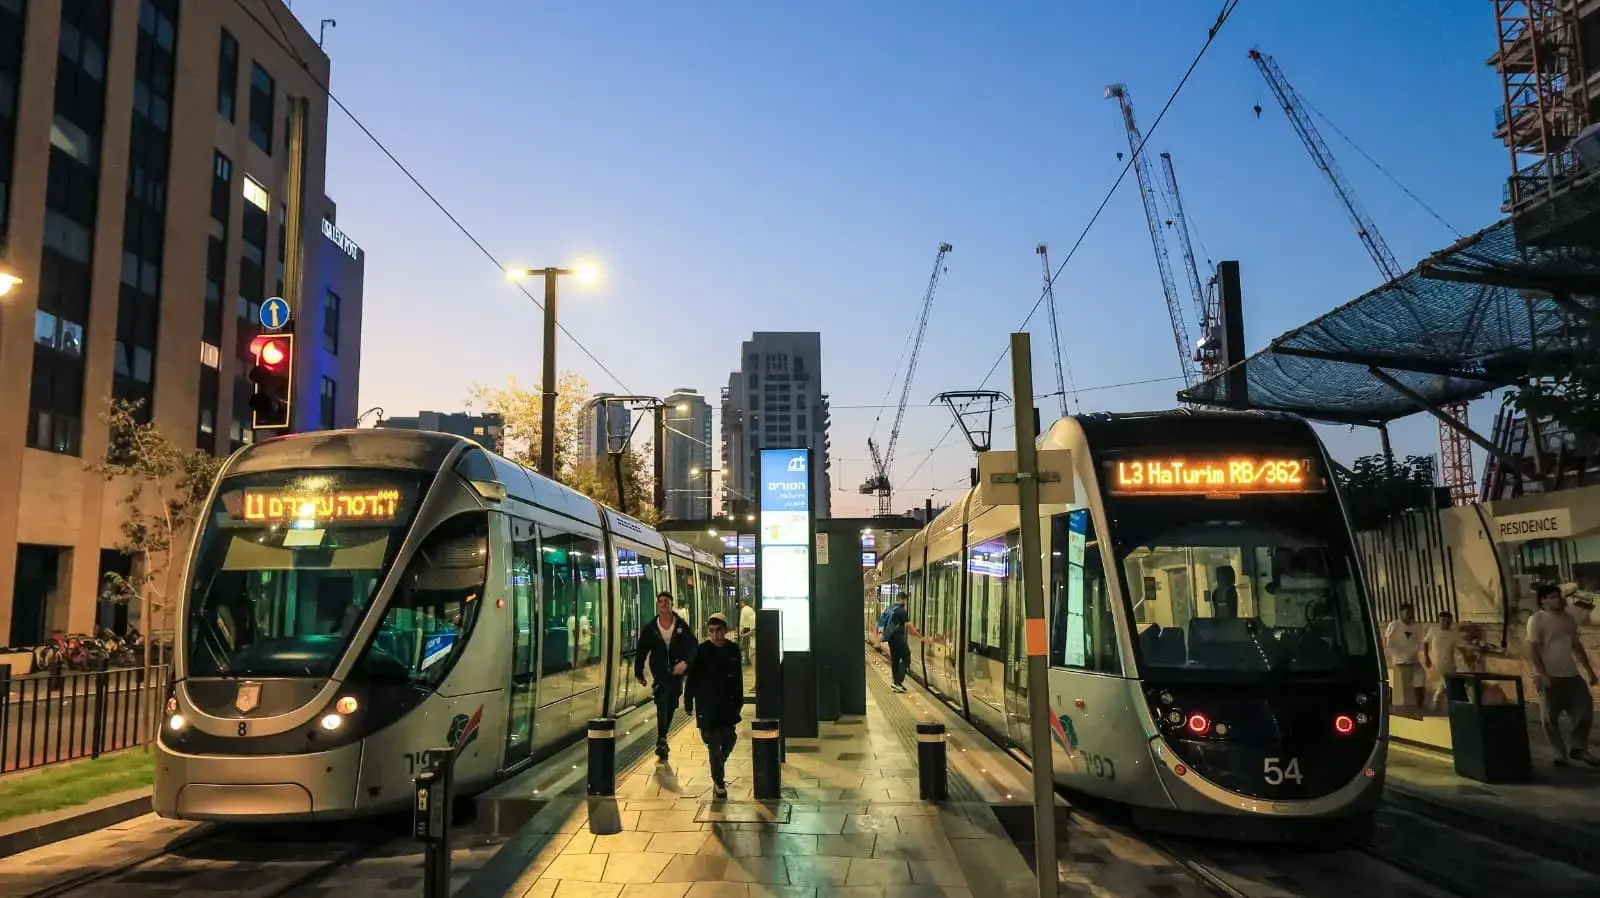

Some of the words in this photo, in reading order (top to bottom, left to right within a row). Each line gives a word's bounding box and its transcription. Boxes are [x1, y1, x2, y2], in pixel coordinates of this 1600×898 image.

[1119, 462, 1143, 485] L3
[1148, 462, 1225, 485] HaTurim
[1228, 461, 1301, 484] RB/362
[1500, 517, 1558, 537] RESIDENCE
[238, 721, 247, 737] 8
[1263, 757, 1304, 785] 54
